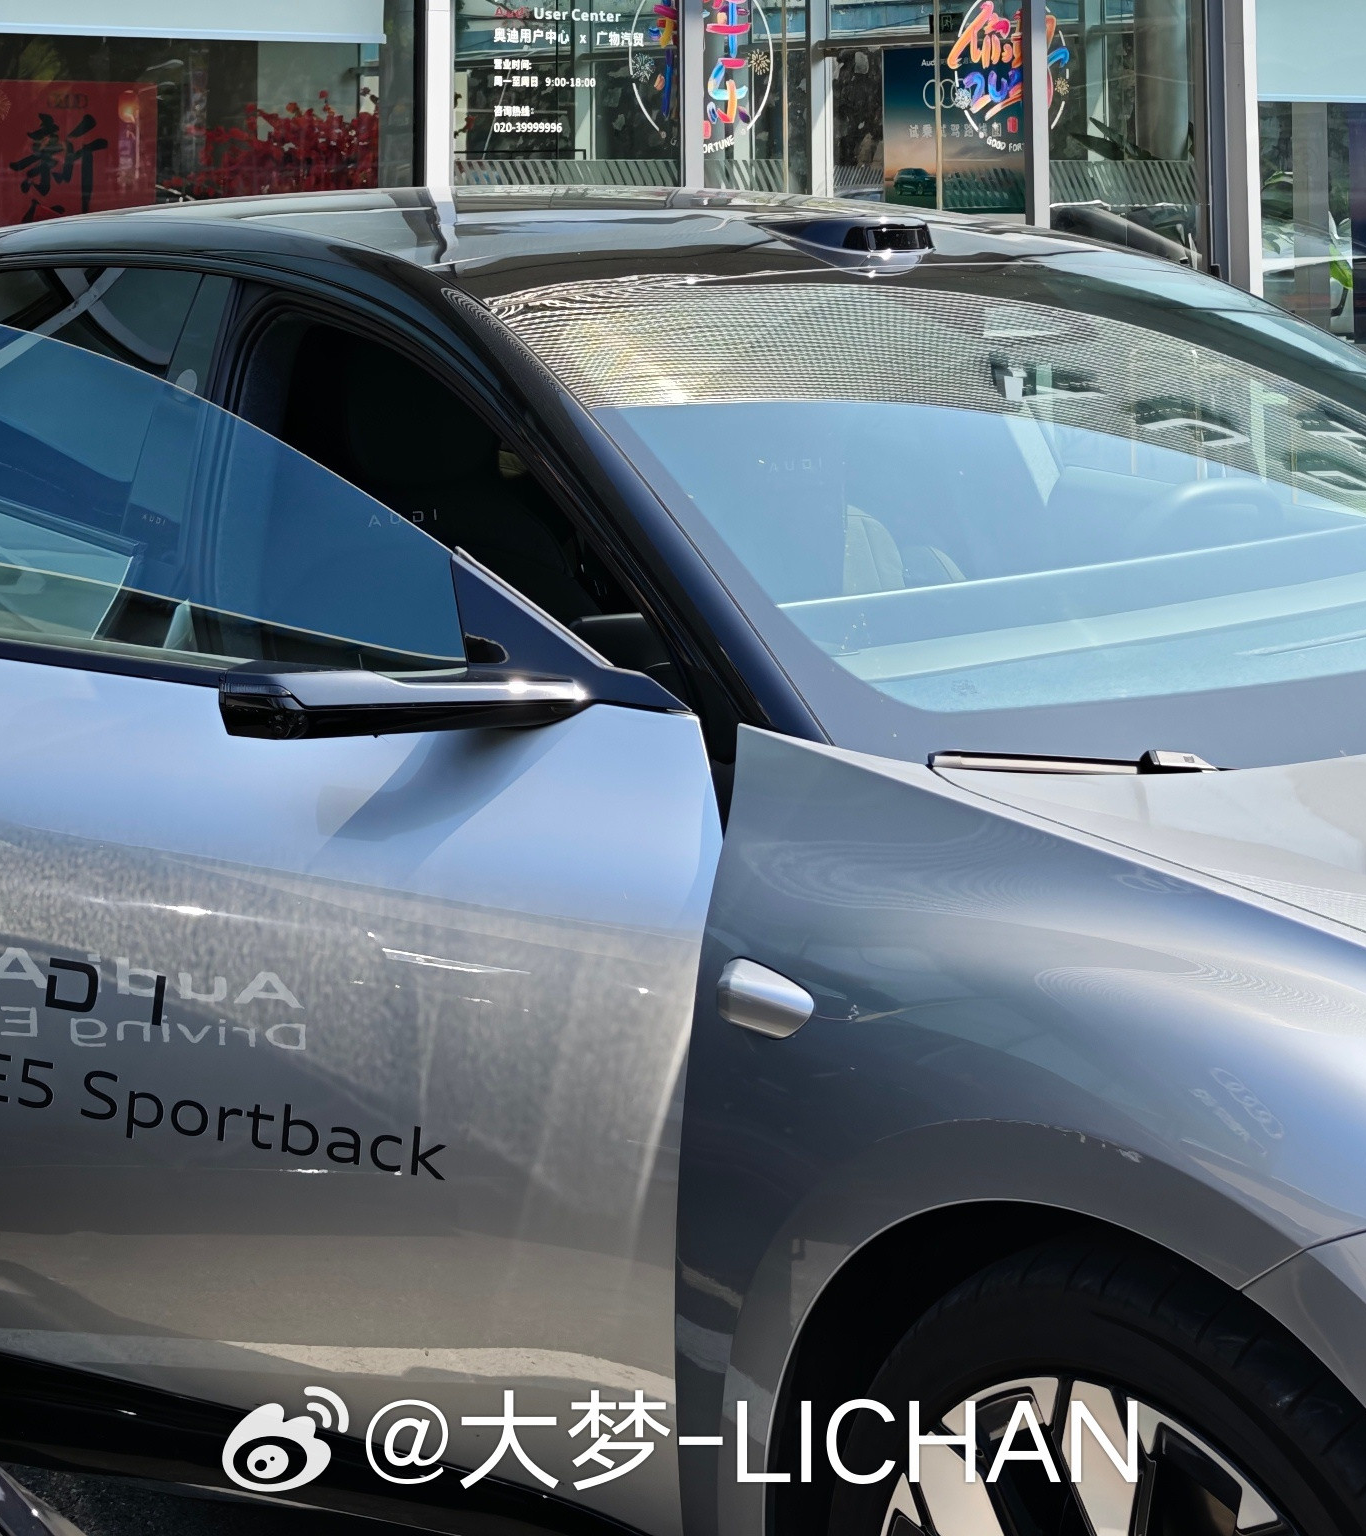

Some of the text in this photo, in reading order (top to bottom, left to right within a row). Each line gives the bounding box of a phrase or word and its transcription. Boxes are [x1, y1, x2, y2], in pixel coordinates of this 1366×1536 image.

[533, 7, 569, 21] User
[571, 9, 622, 23] Center
[493, 28, 570, 45] 奥迪用户中心
[596, 31, 645, 47] 广物汽贸
[921, 58, 937, 67] Aud
[493, 76, 597, 88] 周一至周日 9:00-18:00
[493, 122, 563, 133] 020-39999996
[703, 134, 735, 154] ORTUNE
[986, 136, 1025, 153] GOOD FOR
[9, 112, 109, 221] 新
[79, 1068, 448, 1181] Sportback
